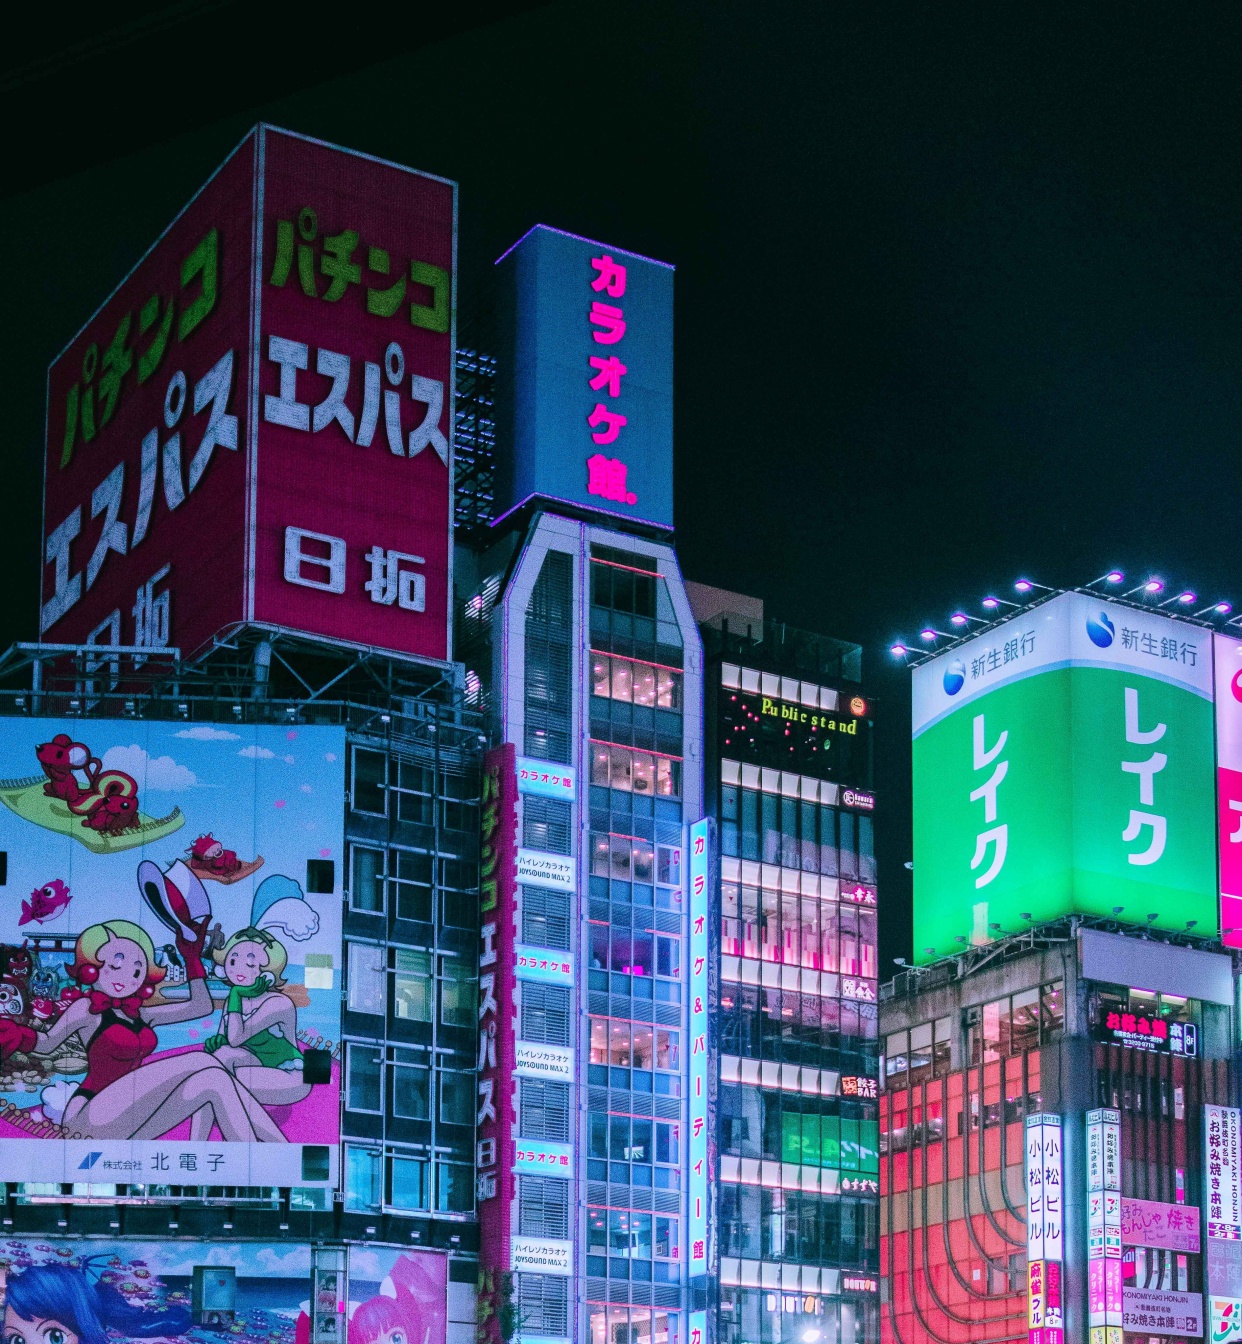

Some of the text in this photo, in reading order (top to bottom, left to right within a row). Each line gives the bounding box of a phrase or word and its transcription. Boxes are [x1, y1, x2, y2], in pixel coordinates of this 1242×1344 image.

[270, 207, 450, 334] パチンコ
[59, 227, 218, 470] パチンコ
[264, 334, 447, 467] エスパス
[41, 348, 239, 637] エスパス
[970, 630, 1036, 679] 新生銀行
[1121, 626, 1198, 667] 新生銀行
[761, 697, 857, 735] Public stand
[520, 769, 572, 788] カラオケ館
[1122, 687, 1168, 866] レイク
[970, 713, 1009, 889] レイク
[481, 765, 500, 913] パチンコ
[519, 867, 551, 879] JOYSOUND
[519, 956, 571, 974] カラオケ館
[478, 921, 497, 1127] エスパス
[1186, 1035, 1195, 1046] 8F
[517, 1060, 549, 1071] JOYSOUND
[857, 1088, 877, 1098] BAR
[102, 1152, 226, 1172] 株式会社 北電子
[516, 1150, 569, 1166] カラオケ館
[1230, 1111, 1238, 1182] OKONOMIYAKI
[1029, 1138, 1042, 1240] 小松ビル
[1045, 1138, 1060, 1240] 小松ビル
[515, 1255, 567, 1267] JOYSOUND MAX 2
[1049, 1317, 1059, 1325] 8F
